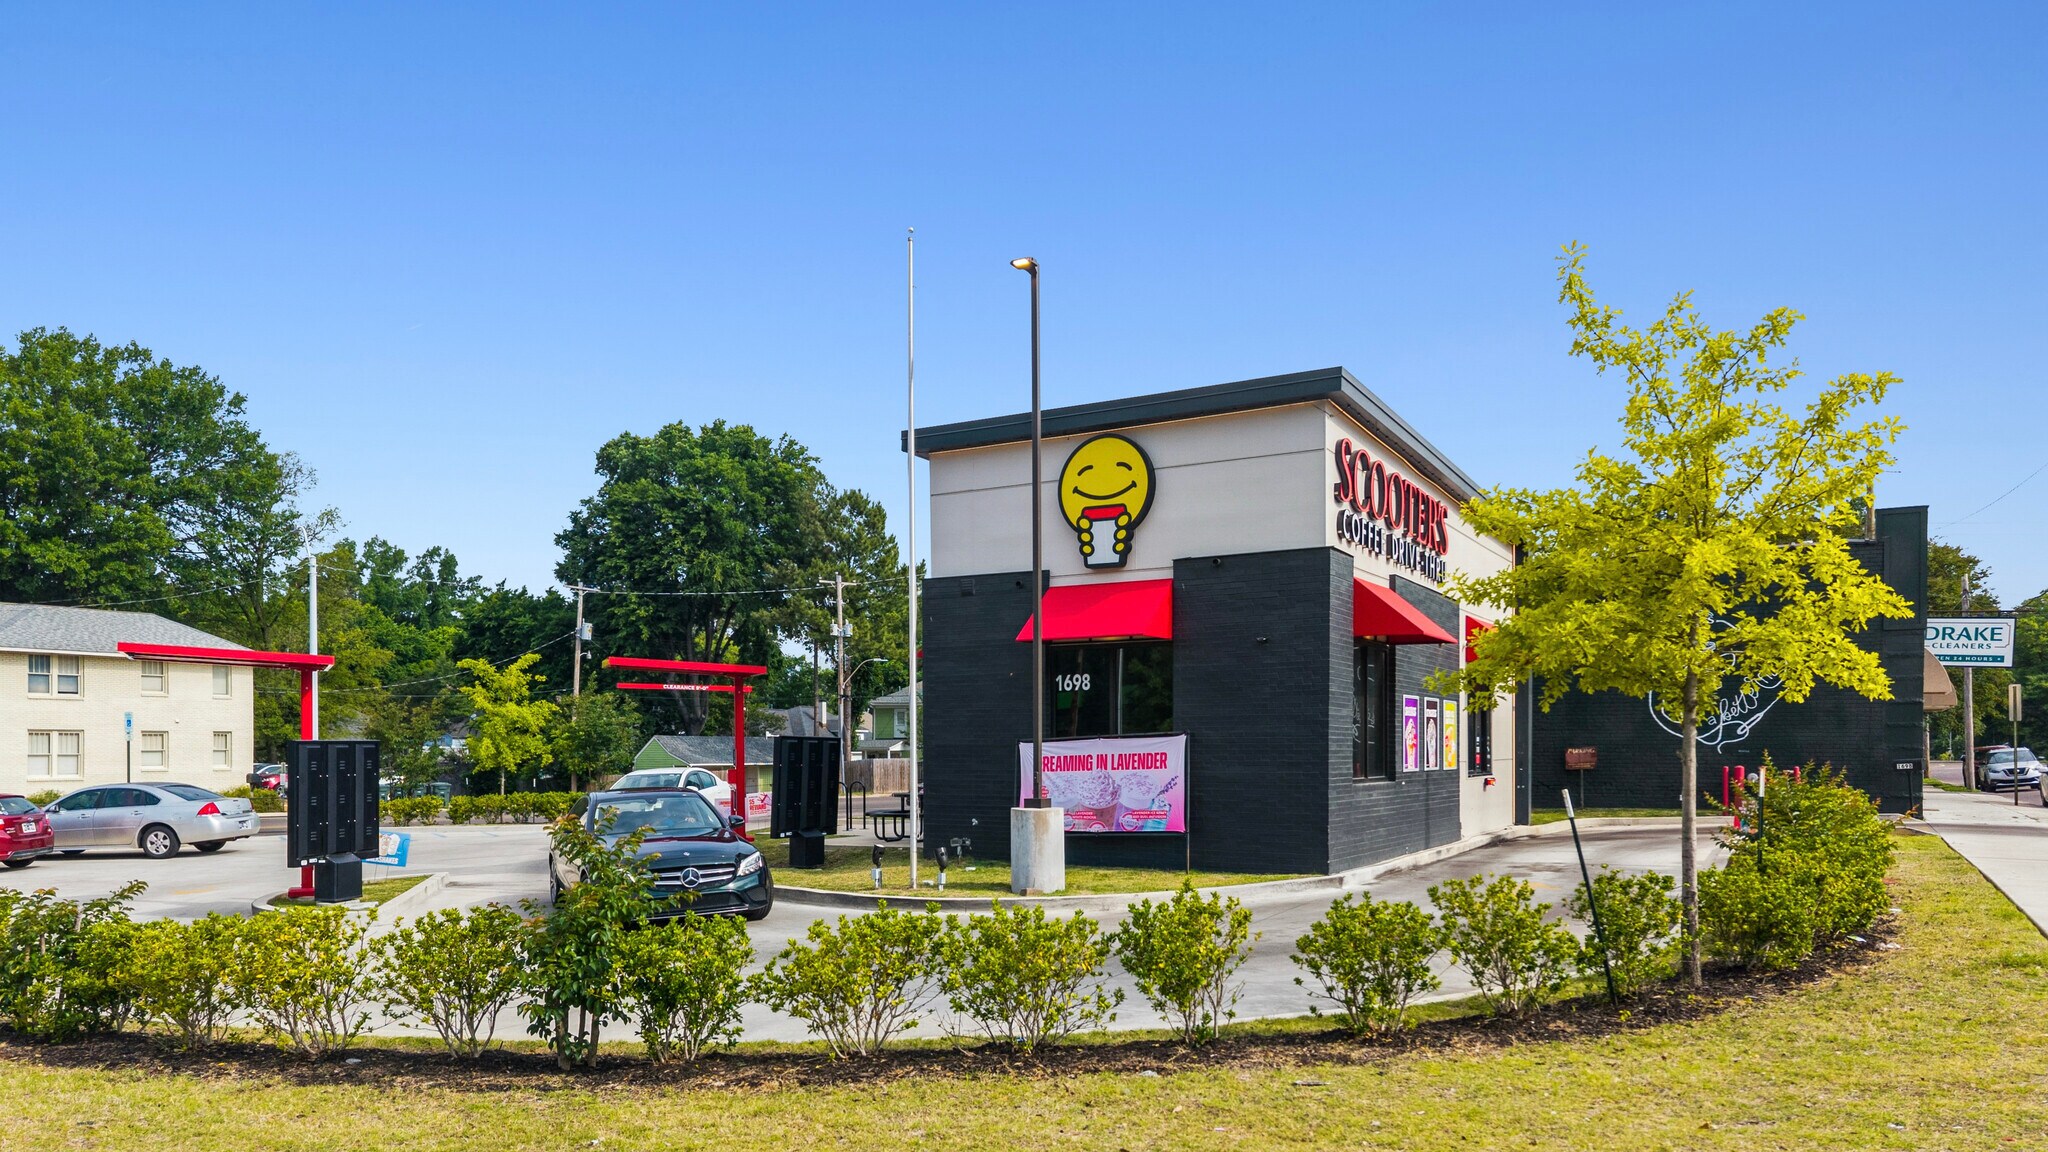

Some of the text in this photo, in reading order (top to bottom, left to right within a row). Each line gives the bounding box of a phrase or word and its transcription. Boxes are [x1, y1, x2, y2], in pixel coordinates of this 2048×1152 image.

[1334, 437, 1449, 556] SCOOTER'S
[1337, 509, 1387, 556] COFFEE
[1924, 627, 2003, 641] DRAKE
[1055, 673, 1091, 692] 1698
[1042, 752, 1167, 772] REAMING IN LAVENDER
